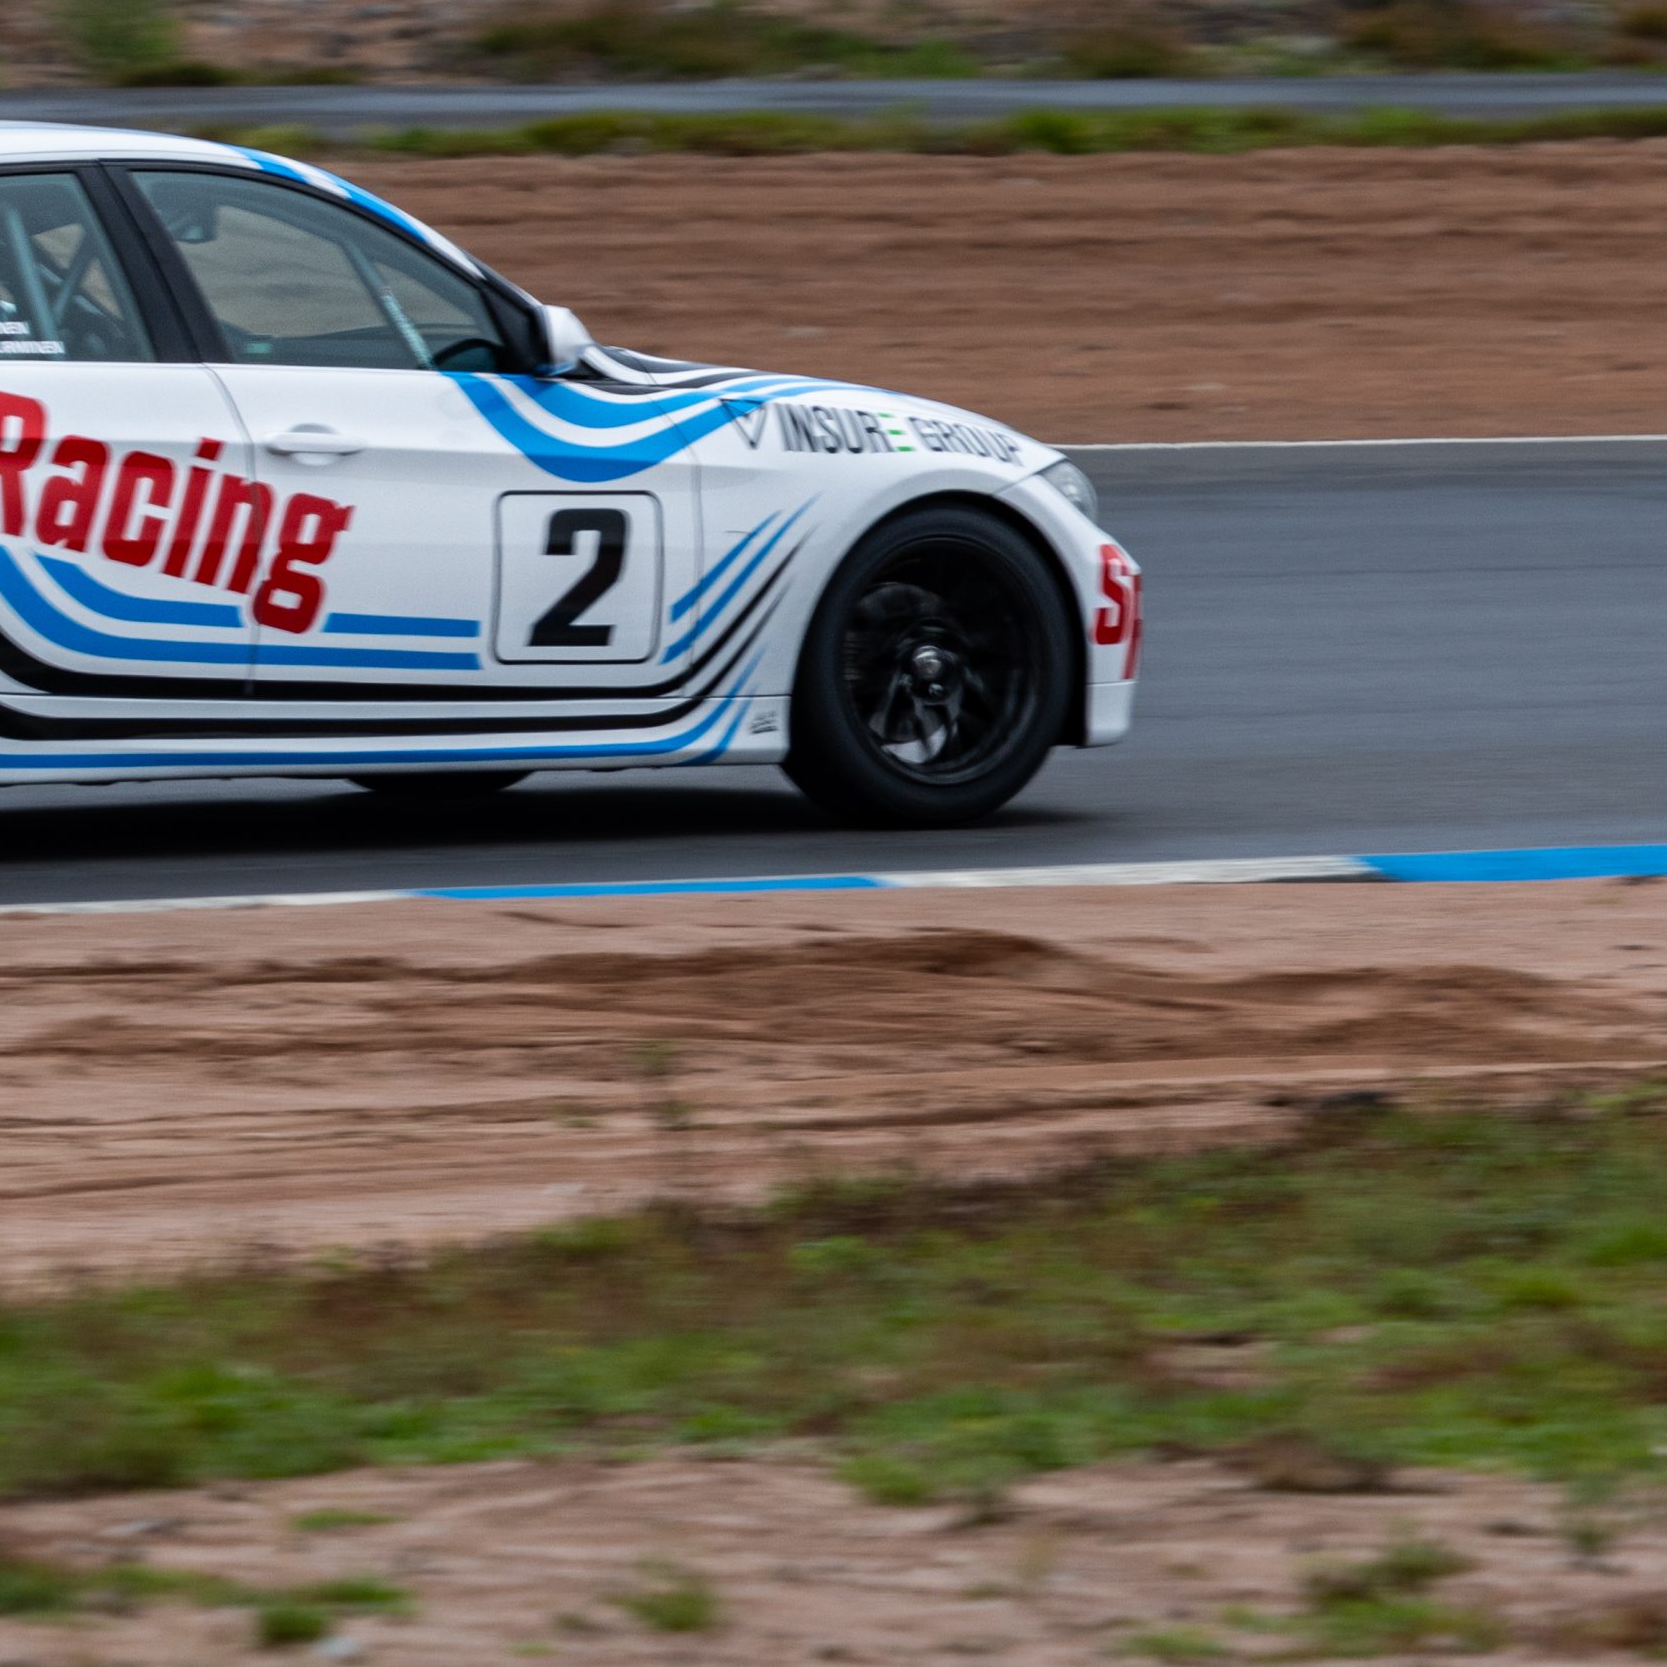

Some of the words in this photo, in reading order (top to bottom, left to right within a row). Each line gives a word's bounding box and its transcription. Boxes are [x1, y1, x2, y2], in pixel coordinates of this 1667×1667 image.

[774, 403, 915, 454] INSURE
[908, 417, 1024, 466] GROUP
[527, 508, 630, 647] 2
